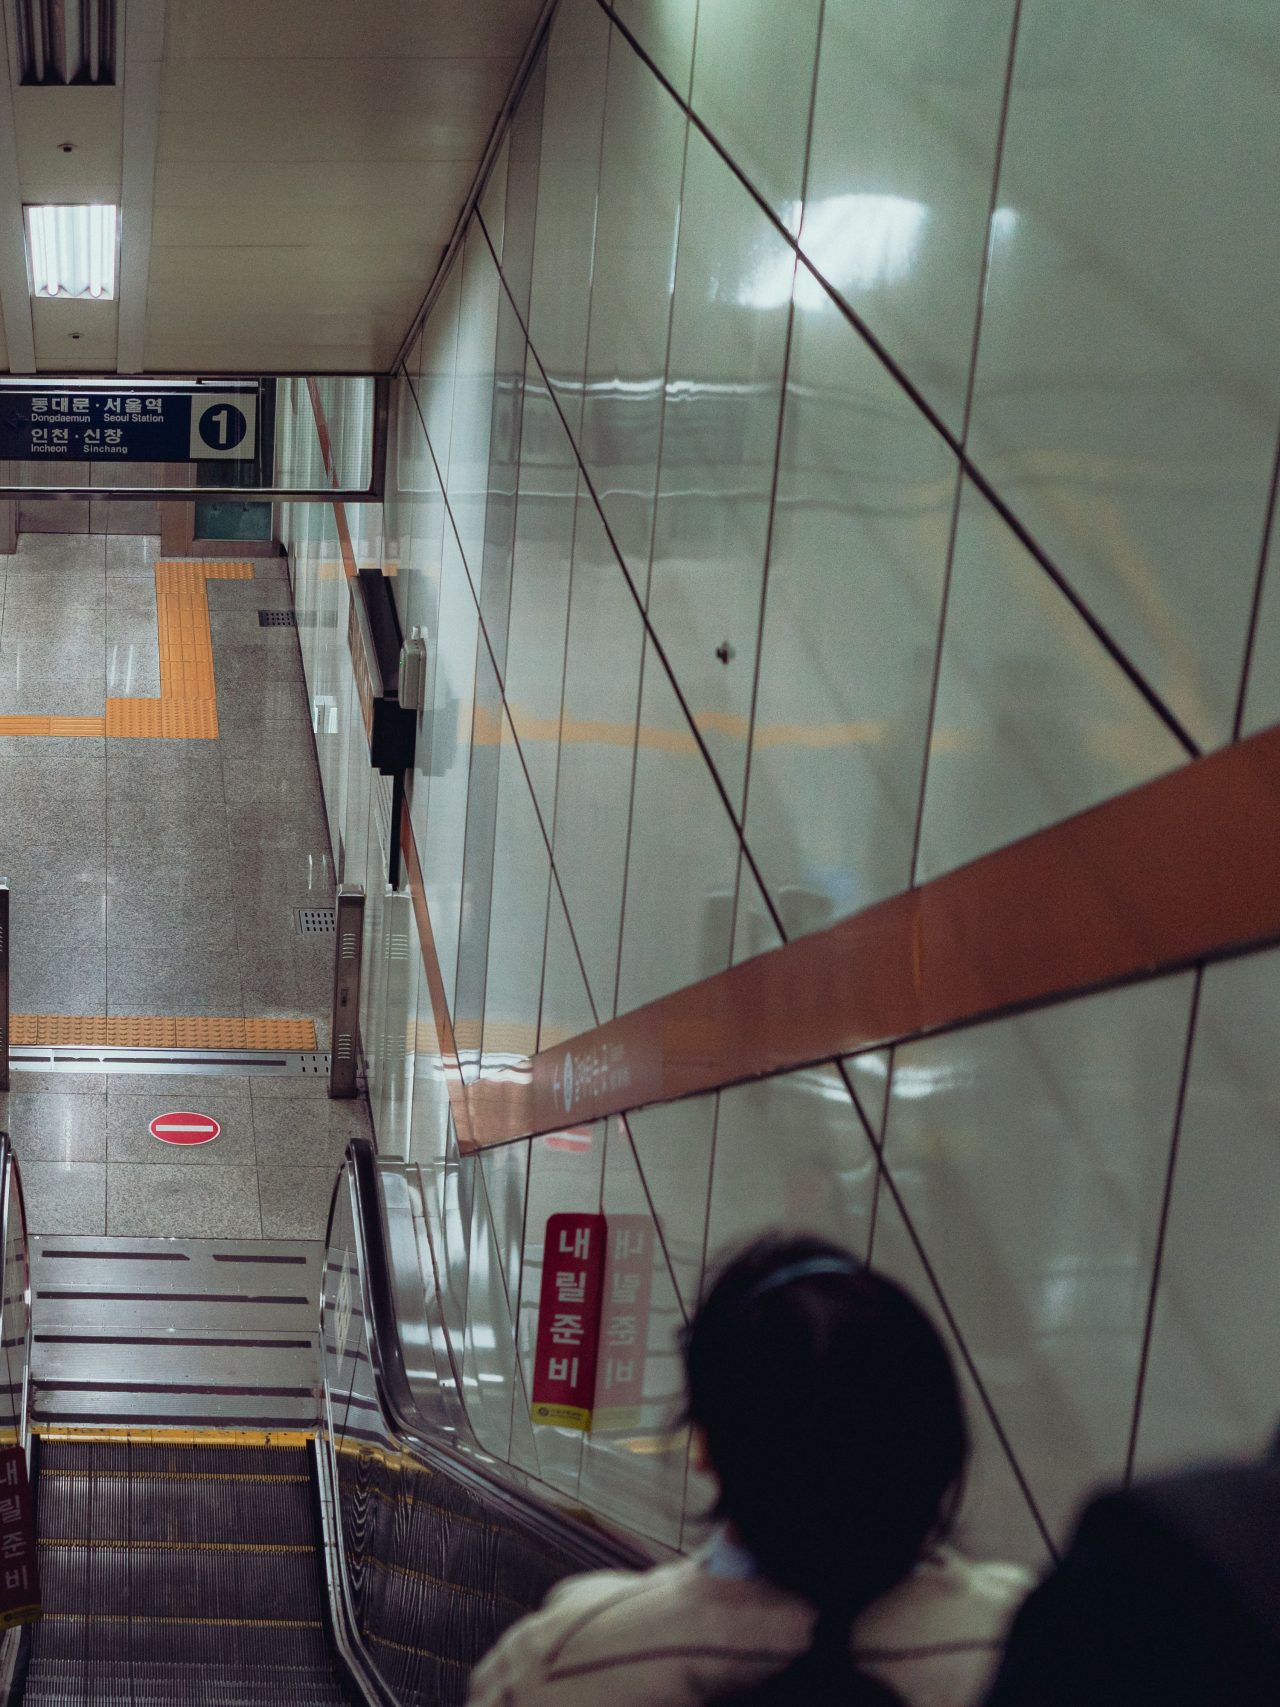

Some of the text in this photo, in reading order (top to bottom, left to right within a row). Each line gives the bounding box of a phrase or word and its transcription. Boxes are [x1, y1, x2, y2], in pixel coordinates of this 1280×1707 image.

[31, 413, 164, 423] Dongdaemun Seoul Station
[211, 409, 229, 445] 1
[31, 444, 128, 454] Incheon Sinchang
